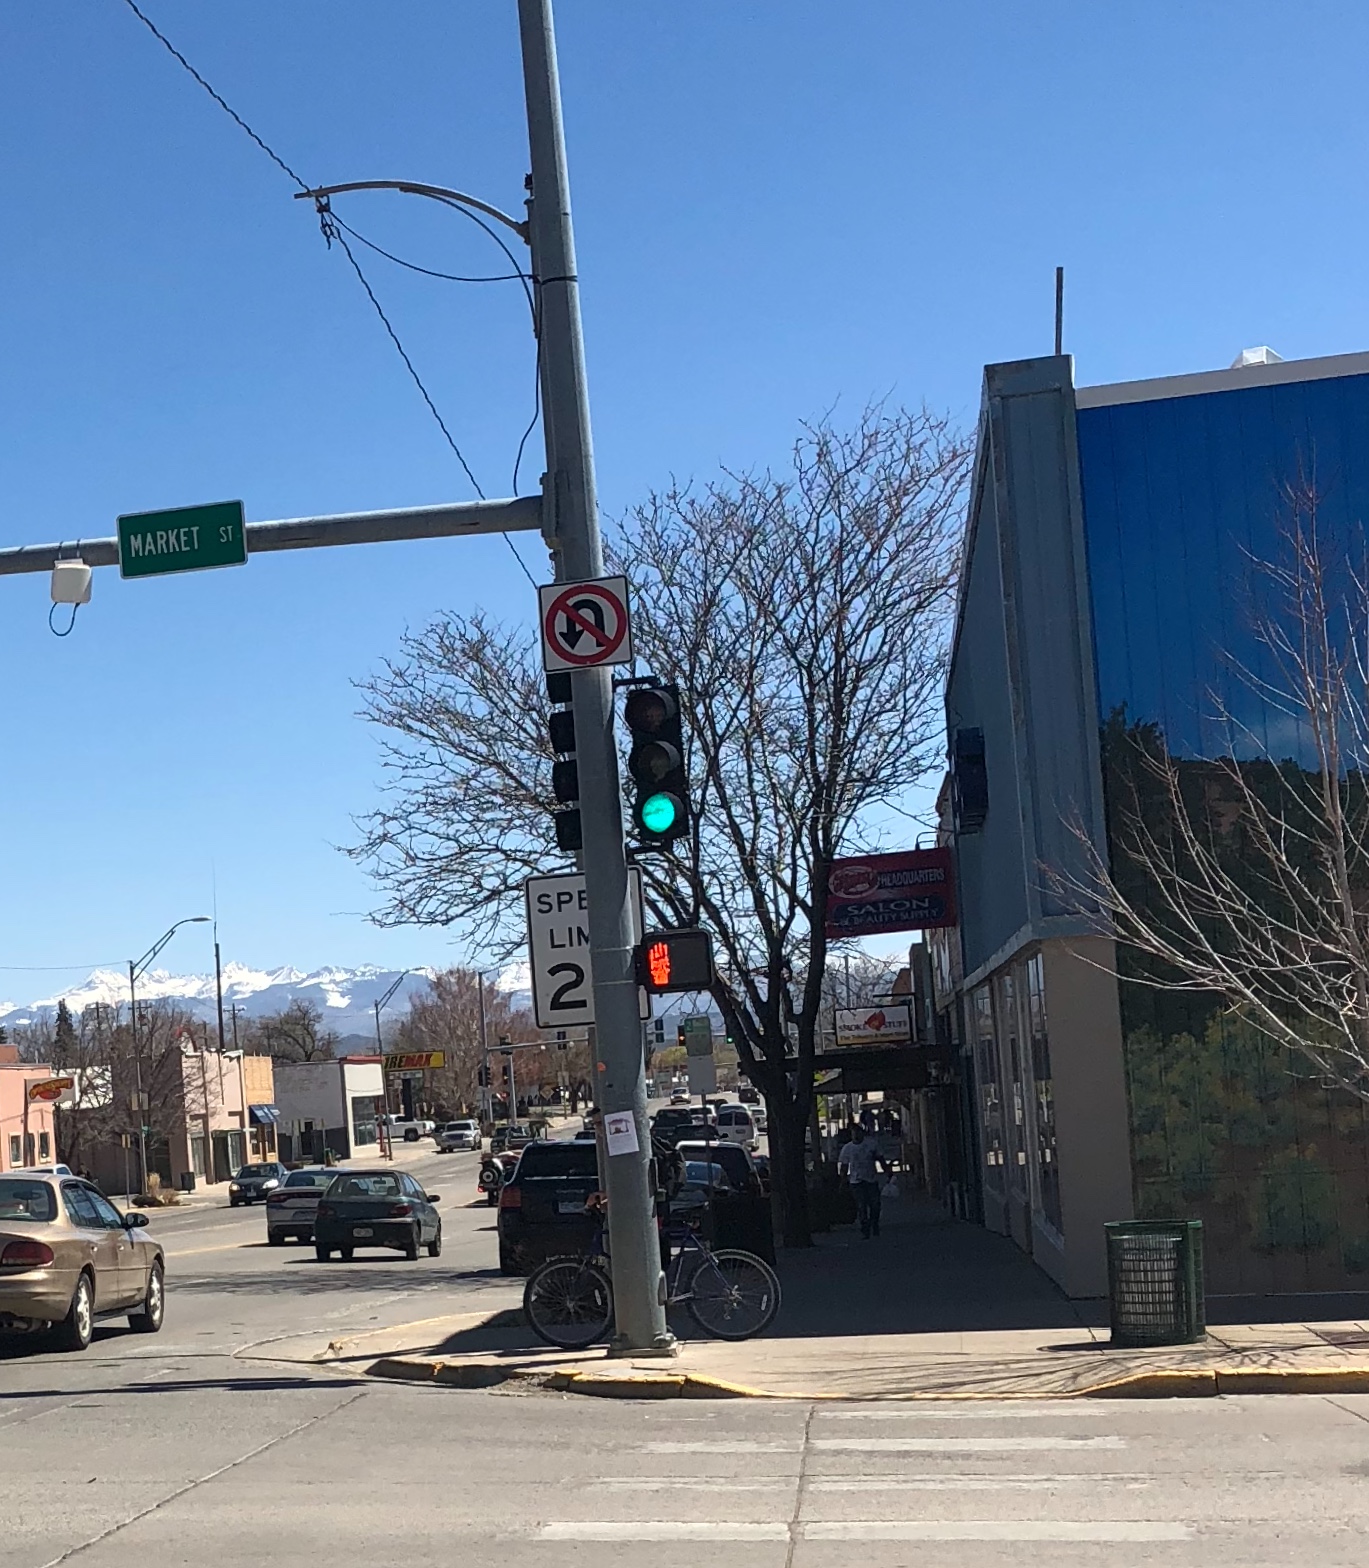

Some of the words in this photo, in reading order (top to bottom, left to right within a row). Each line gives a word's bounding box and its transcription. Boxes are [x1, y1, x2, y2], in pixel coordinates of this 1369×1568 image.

[130, 527, 199, 557] MARKET
[219, 526, 233, 543] ST
[536, 890, 588, 914] SPE
[847, 898, 930, 916] SALON
[549, 926, 590, 949] LIM
[547, 962, 588, 1011] 2
